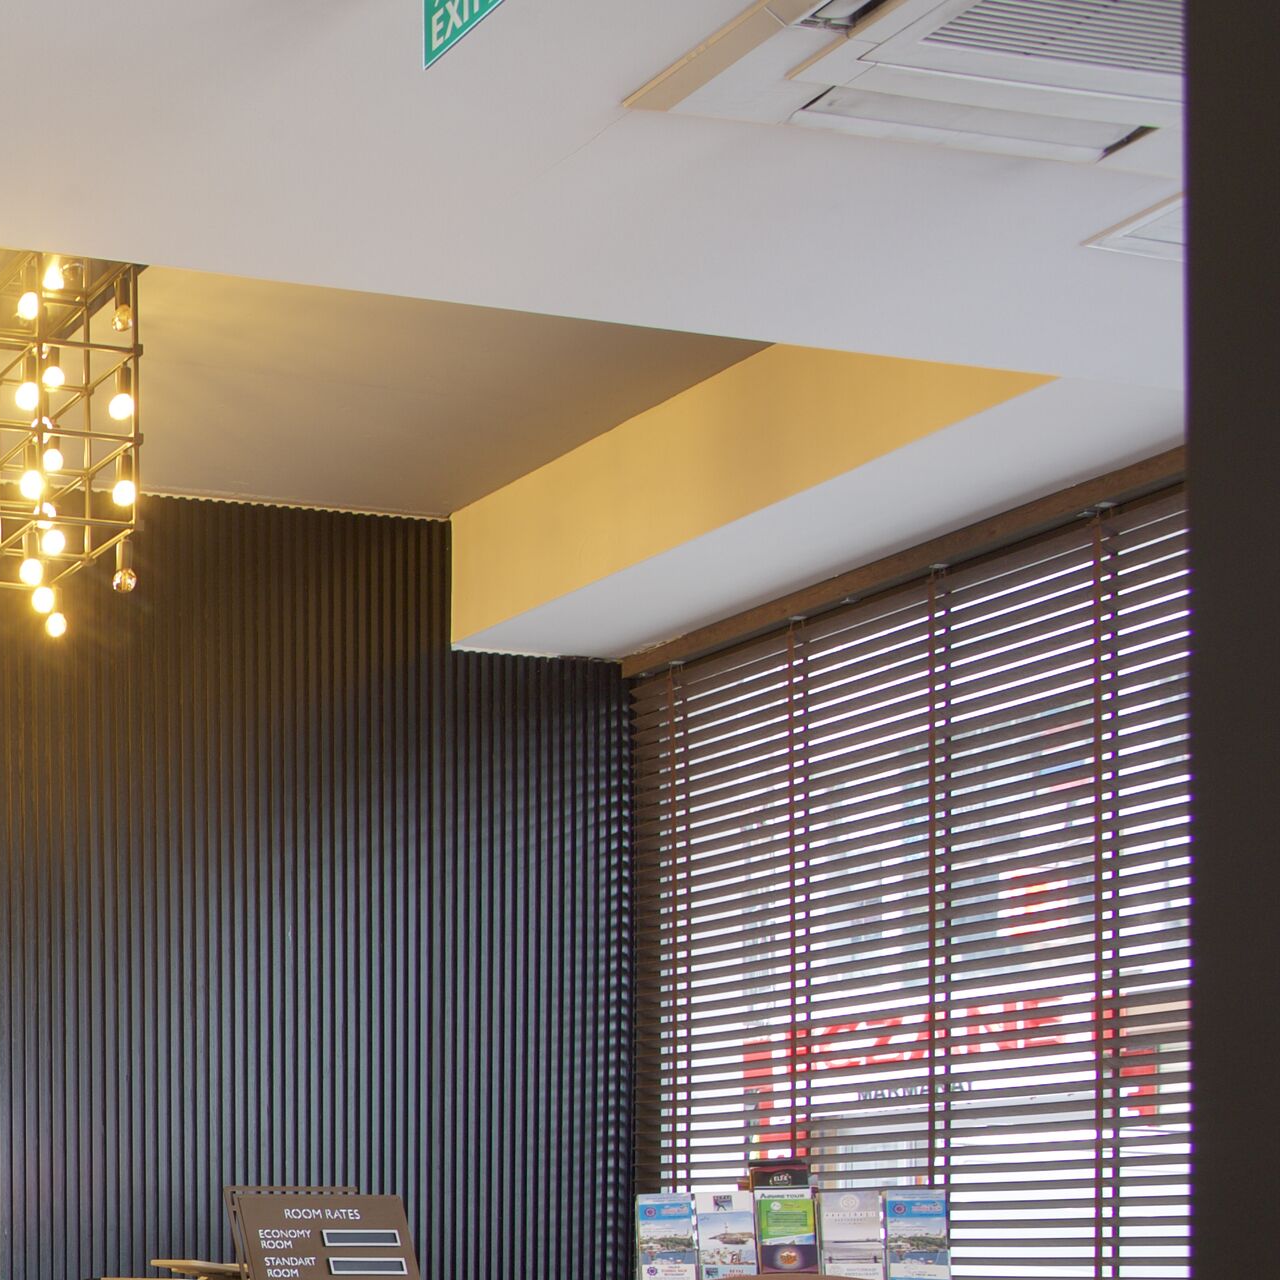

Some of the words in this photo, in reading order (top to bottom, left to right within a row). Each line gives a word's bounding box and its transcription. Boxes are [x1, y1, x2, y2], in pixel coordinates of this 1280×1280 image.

[284, 1208, 323, 1220] ROOM
[325, 1208, 361, 1220] RATES
[258, 1229, 312, 1239] ECONOMY
[261, 1240, 293, 1250] ROOM
[264, 1256, 316, 1266] STANDART
[266, 1268, 299, 1278] ROOM
